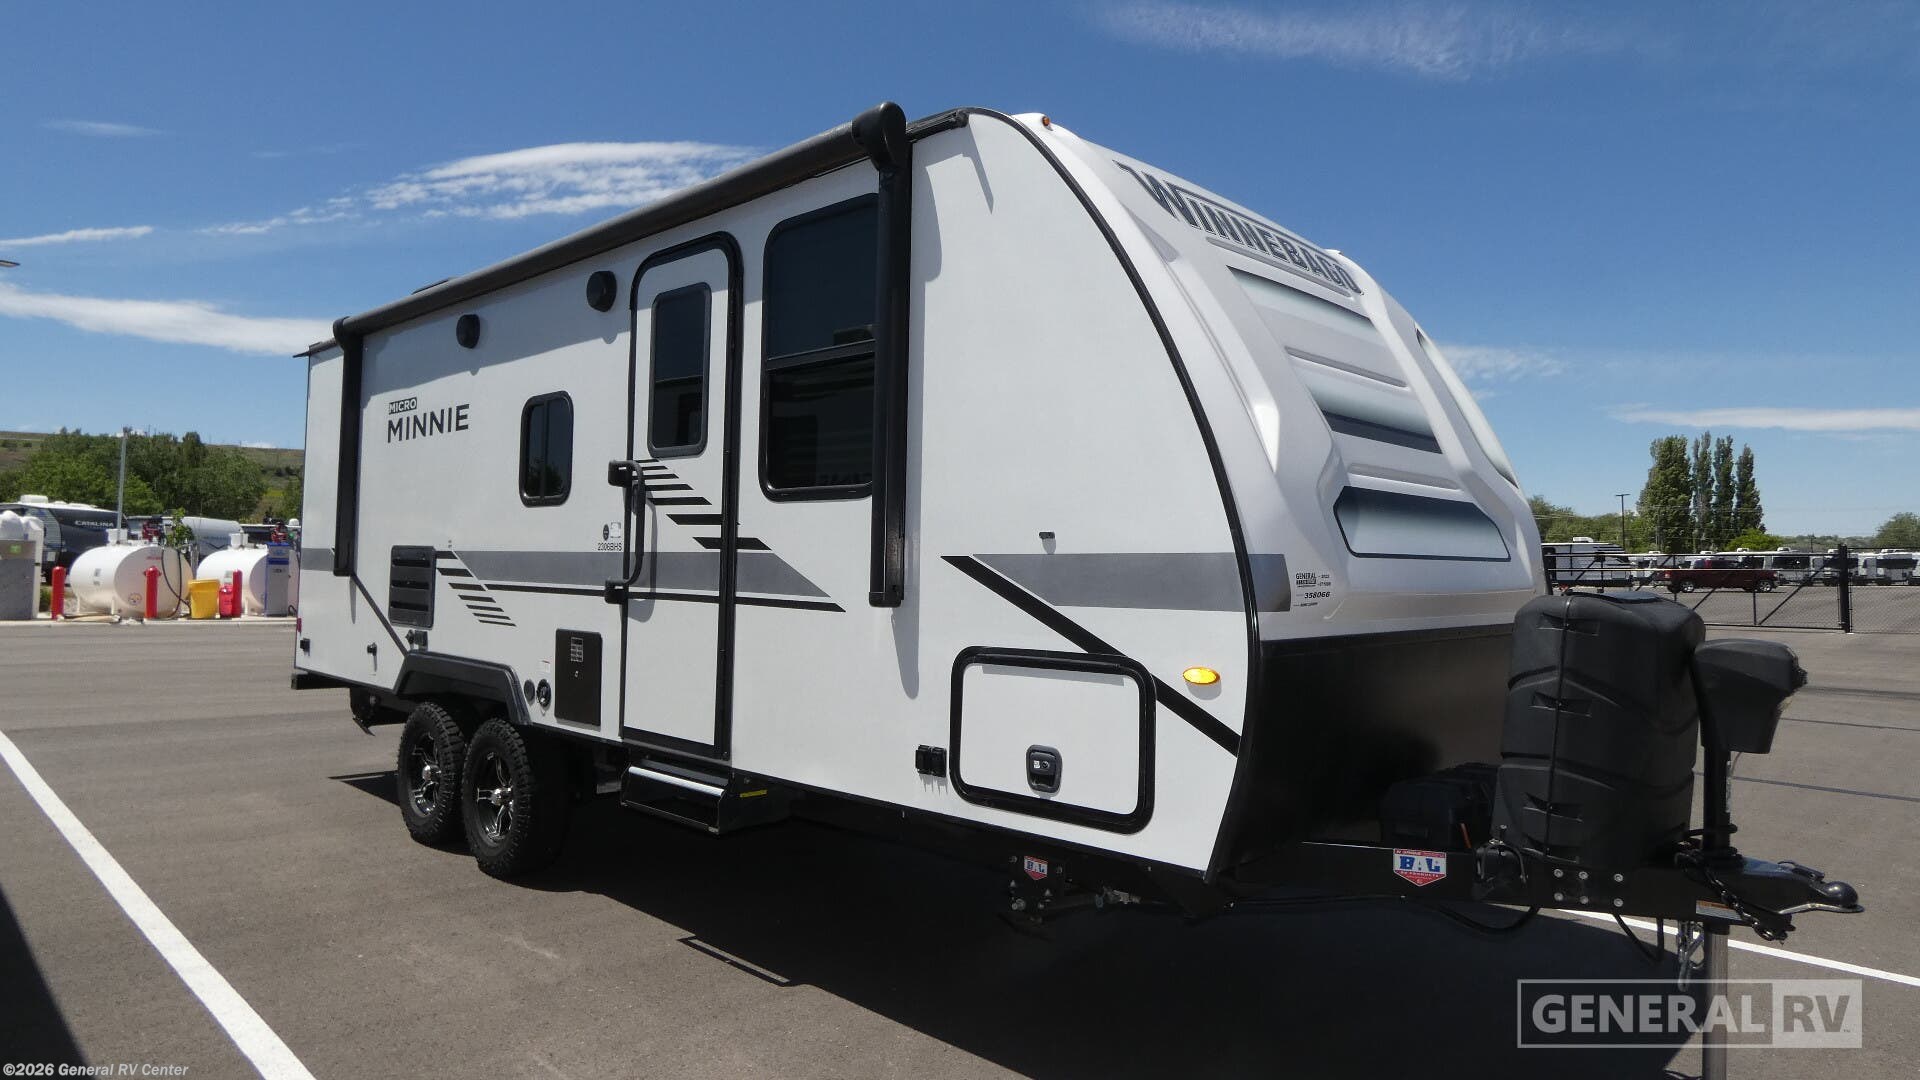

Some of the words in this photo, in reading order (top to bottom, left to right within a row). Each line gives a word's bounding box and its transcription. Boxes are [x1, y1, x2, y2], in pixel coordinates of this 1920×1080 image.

[1112, 160, 1364, 295] WINNEBAGO
[389, 398, 417, 414] MICRO
[388, 404, 470, 443] MINNIE
[1400, 855, 1441, 872] BAL
